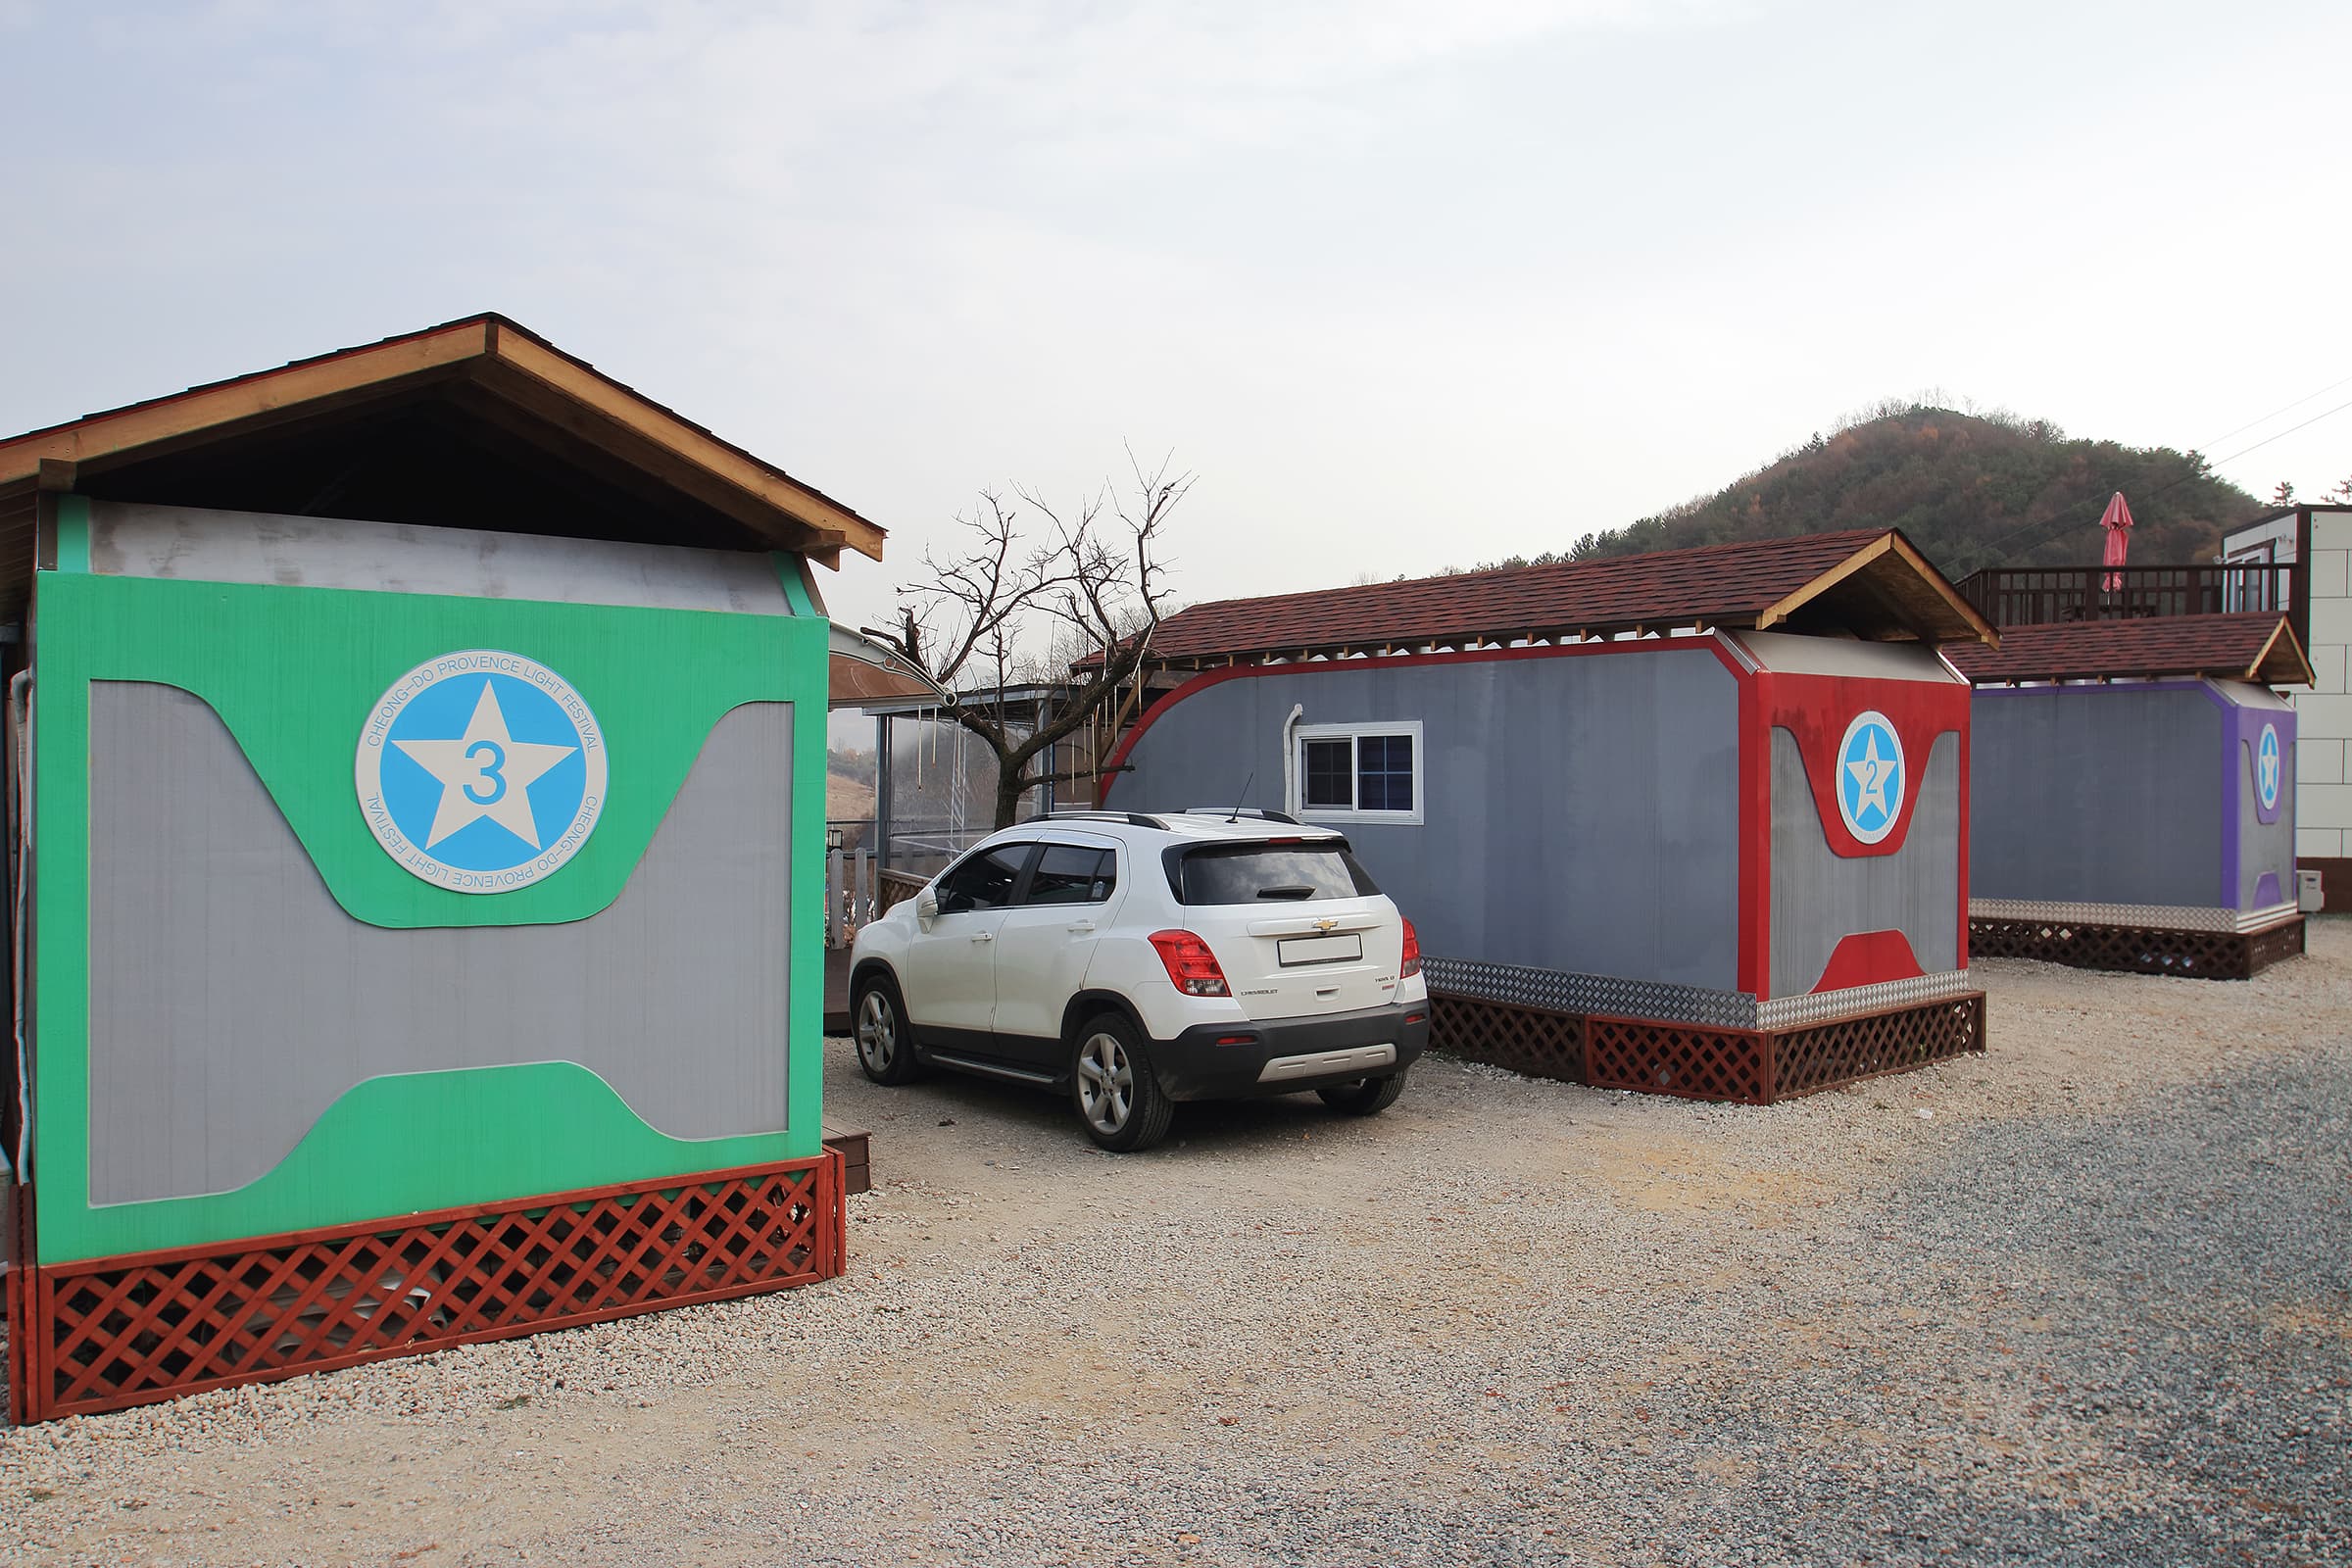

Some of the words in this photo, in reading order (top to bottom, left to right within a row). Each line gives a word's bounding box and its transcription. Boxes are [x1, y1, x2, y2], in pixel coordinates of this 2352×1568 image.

[368, 668, 434, 747] CHEONG-DO
[438, 656, 520, 676] PROVENCE
[523, 665, 564, 695] LIGHT
[562, 693, 599, 753] FESTIVAL
[463, 740, 507, 806] 3
[1865, 760, 1878, 795] 2
[367, 792, 408, 855] FESTIVAL
[537, 795, 598, 871] CHEONG-DO
[406, 852, 448, 880] LIGHT
[452, 866, 534, 888] PROVENCE
